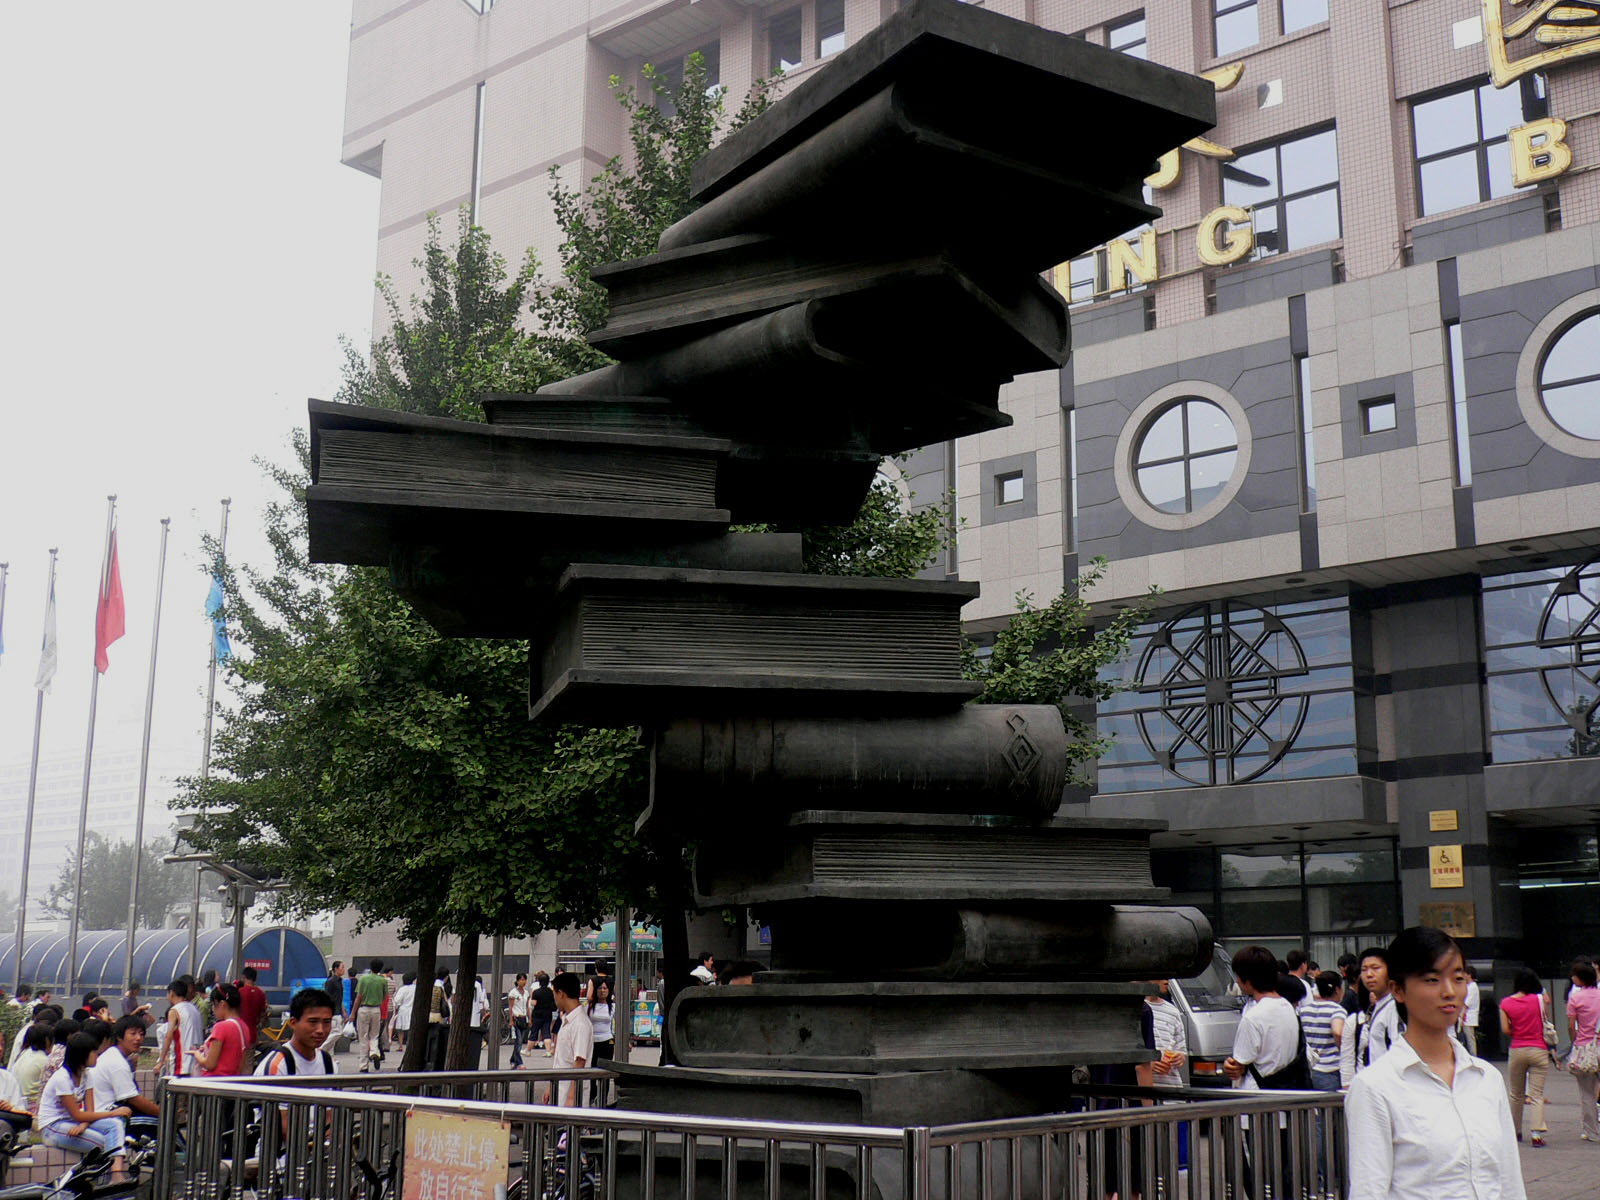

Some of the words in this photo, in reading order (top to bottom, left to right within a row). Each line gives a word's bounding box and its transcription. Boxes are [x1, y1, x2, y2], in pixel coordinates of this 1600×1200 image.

[413, 1127, 497, 1172] 此处禁止停
